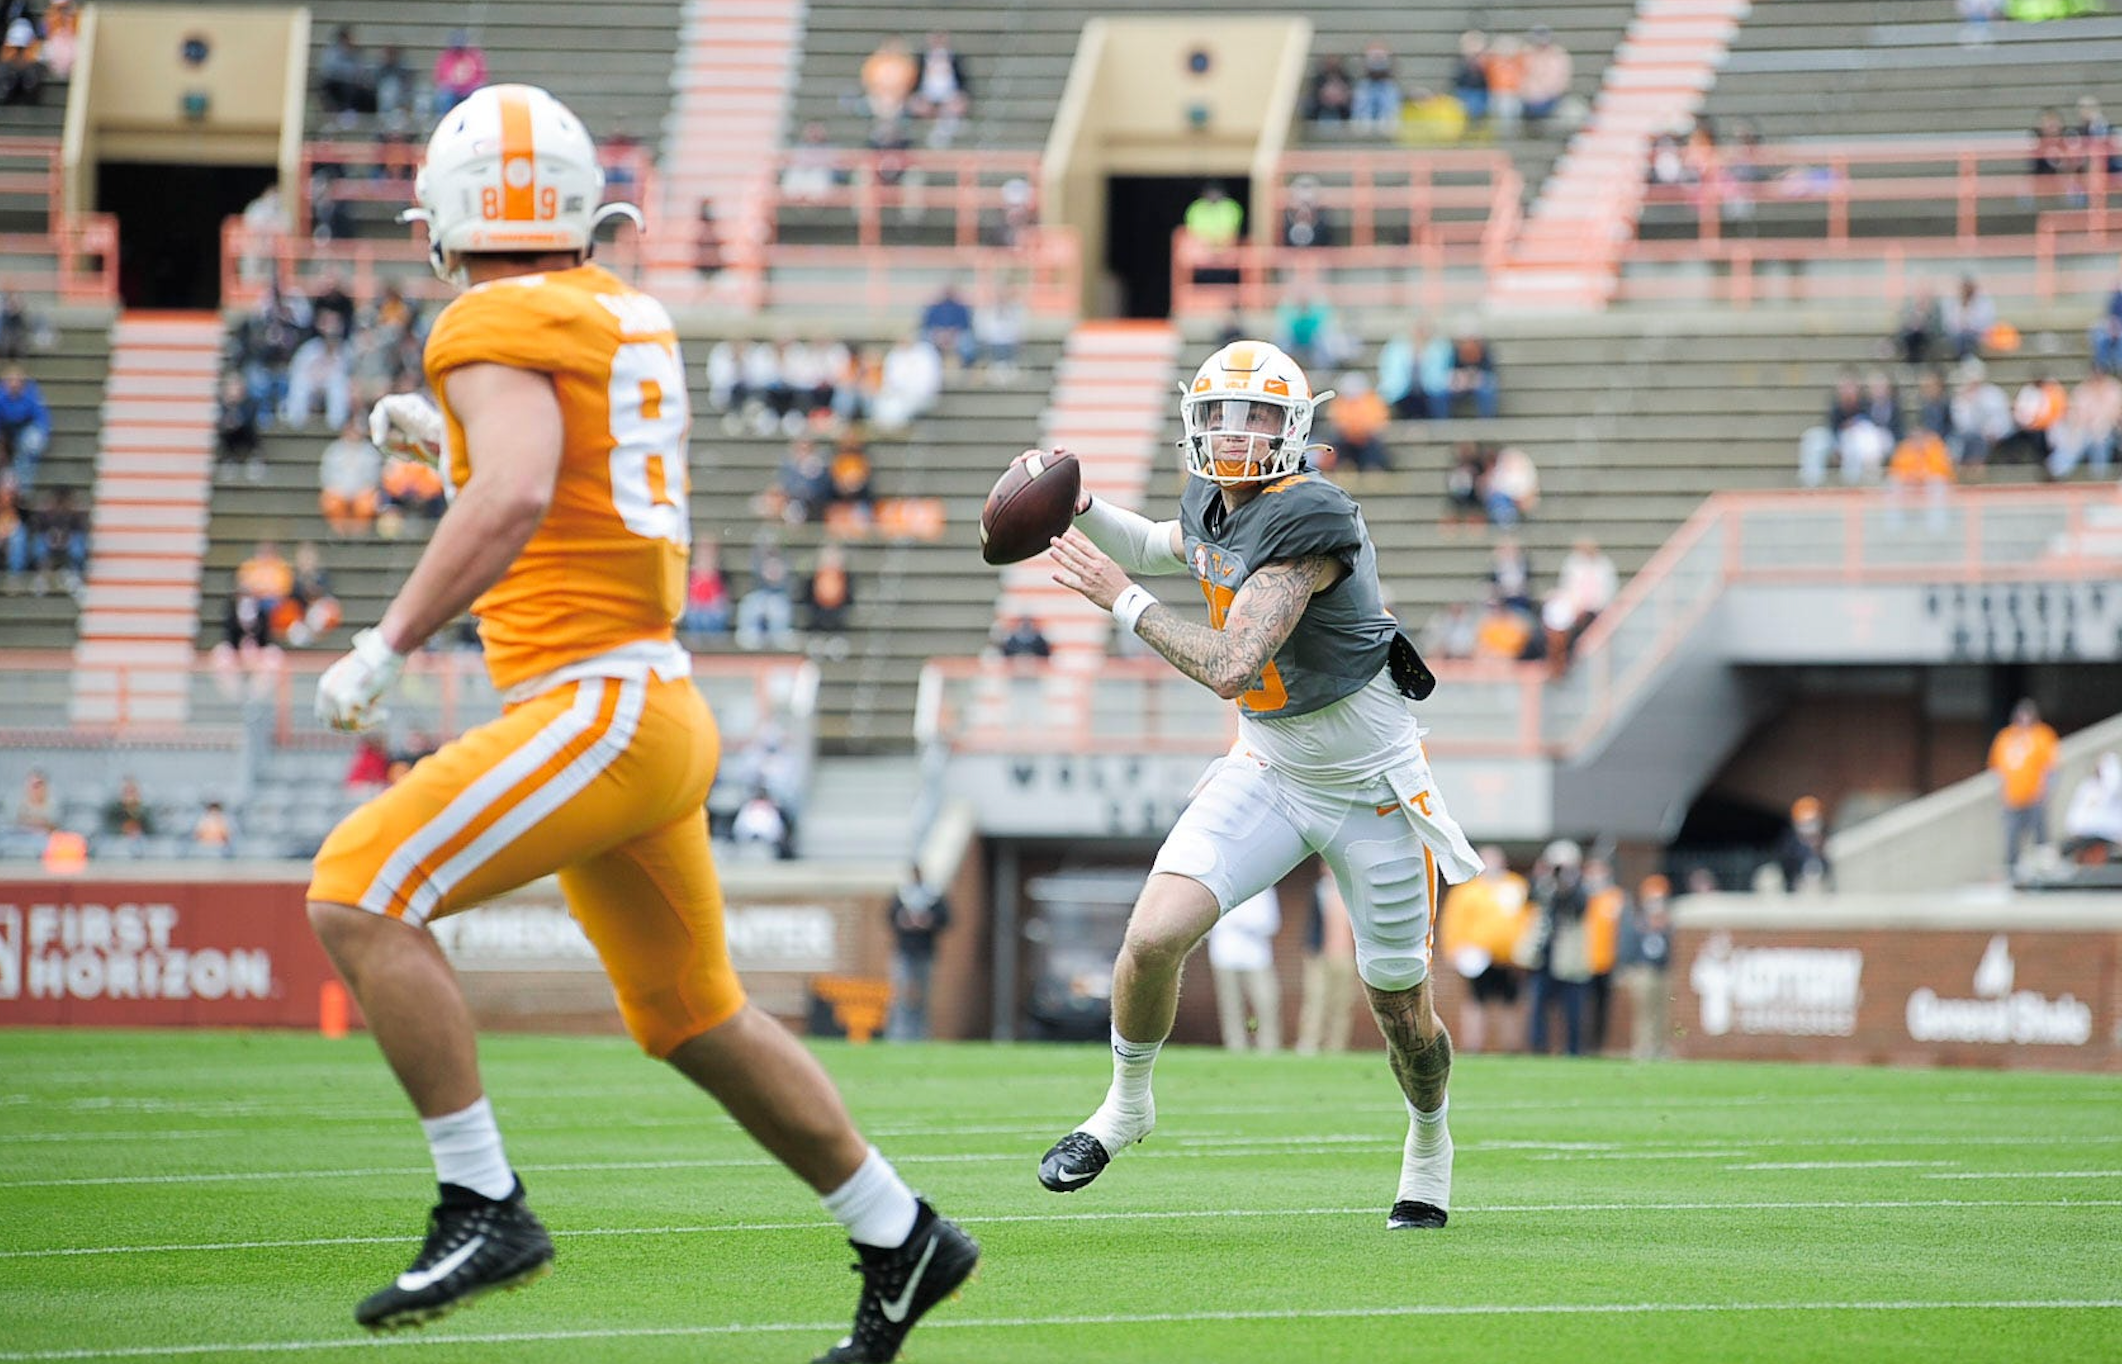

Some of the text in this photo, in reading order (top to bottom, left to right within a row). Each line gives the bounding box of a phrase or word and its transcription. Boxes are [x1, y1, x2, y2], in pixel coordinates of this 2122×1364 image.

[481, 187, 499, 221] 8
[541, 187, 558, 221] 9
[608, 340, 692, 546] 8
[1409, 789, 1432, 817] T
[28, 903, 179, 950] FIRST
[27, 948, 271, 1000] HORIZON
